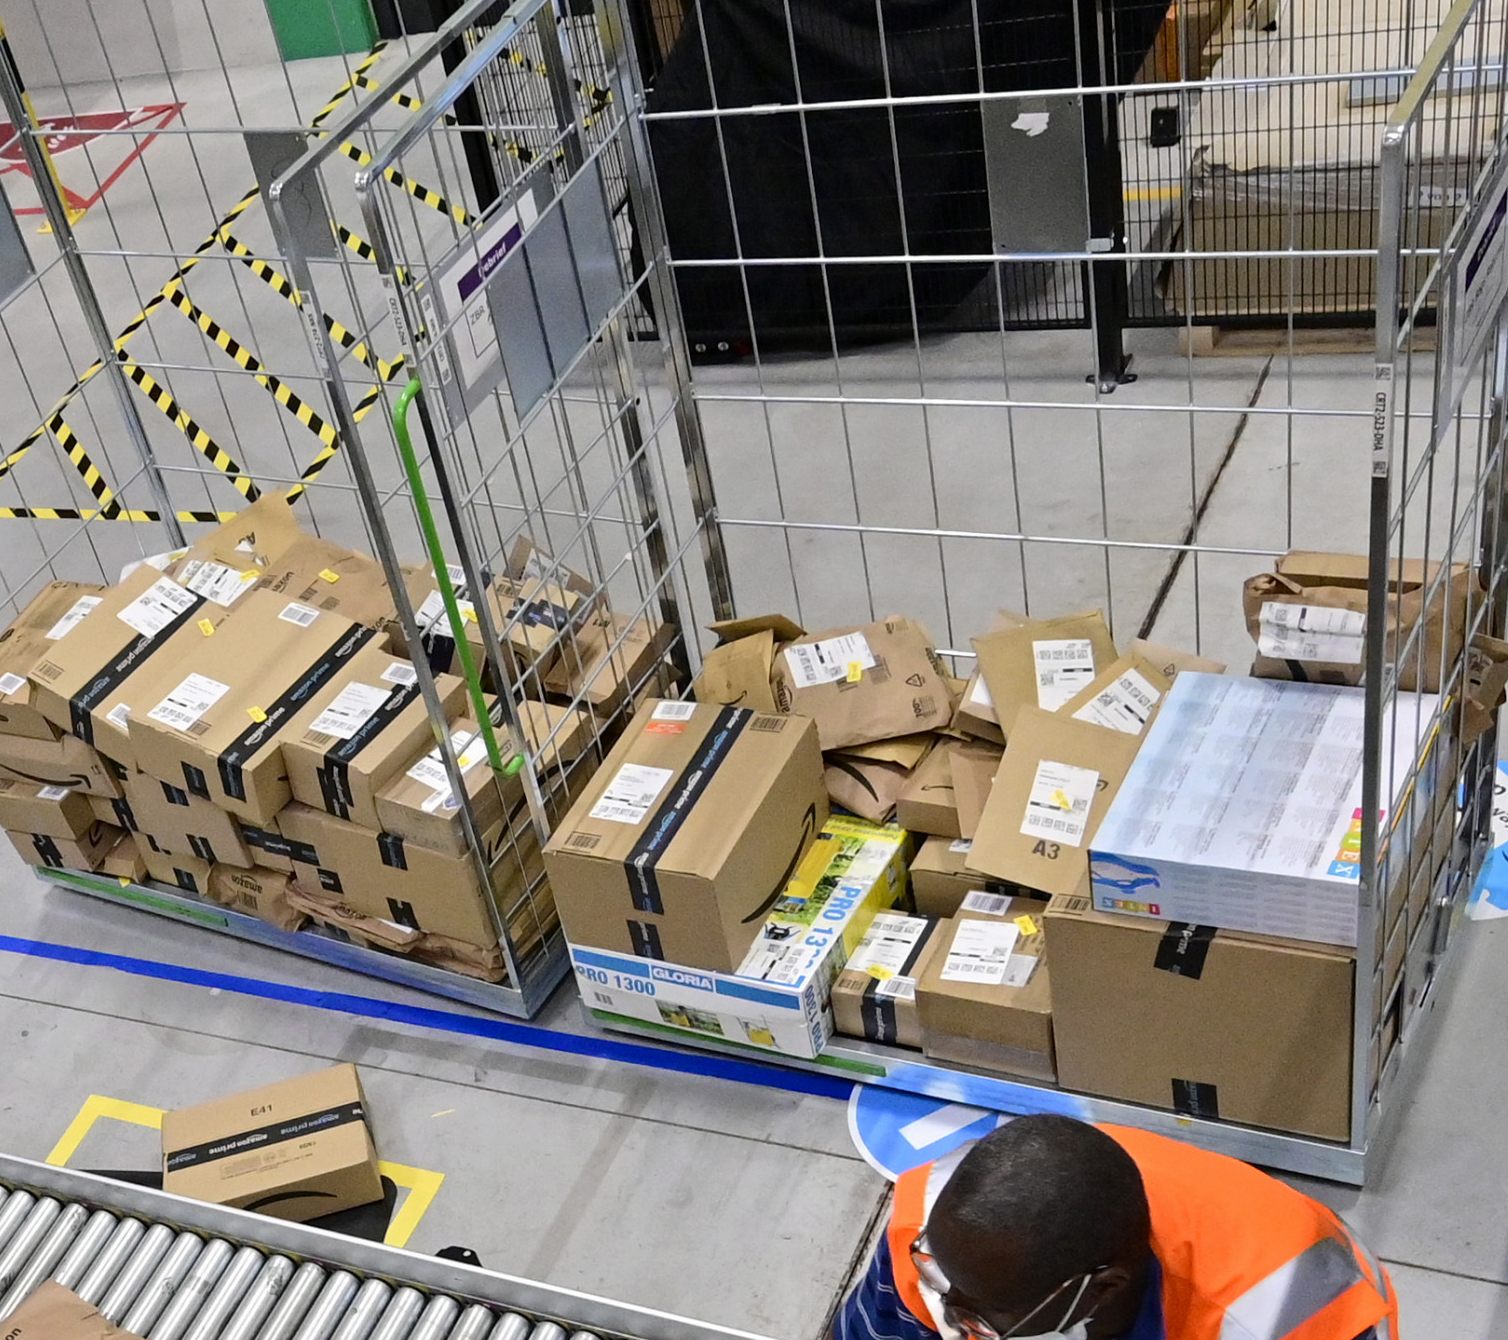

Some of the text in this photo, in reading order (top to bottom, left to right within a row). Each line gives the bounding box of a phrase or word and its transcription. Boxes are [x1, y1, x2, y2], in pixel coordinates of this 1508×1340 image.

[1032, 840, 1060, 860] A3
[823, 886, 862, 921] PRO
[576, 965, 656, 996] PRO 1300
[652, 968, 713, 990] GLORIA
[804, 986, 824, 1051] PRO 1300
